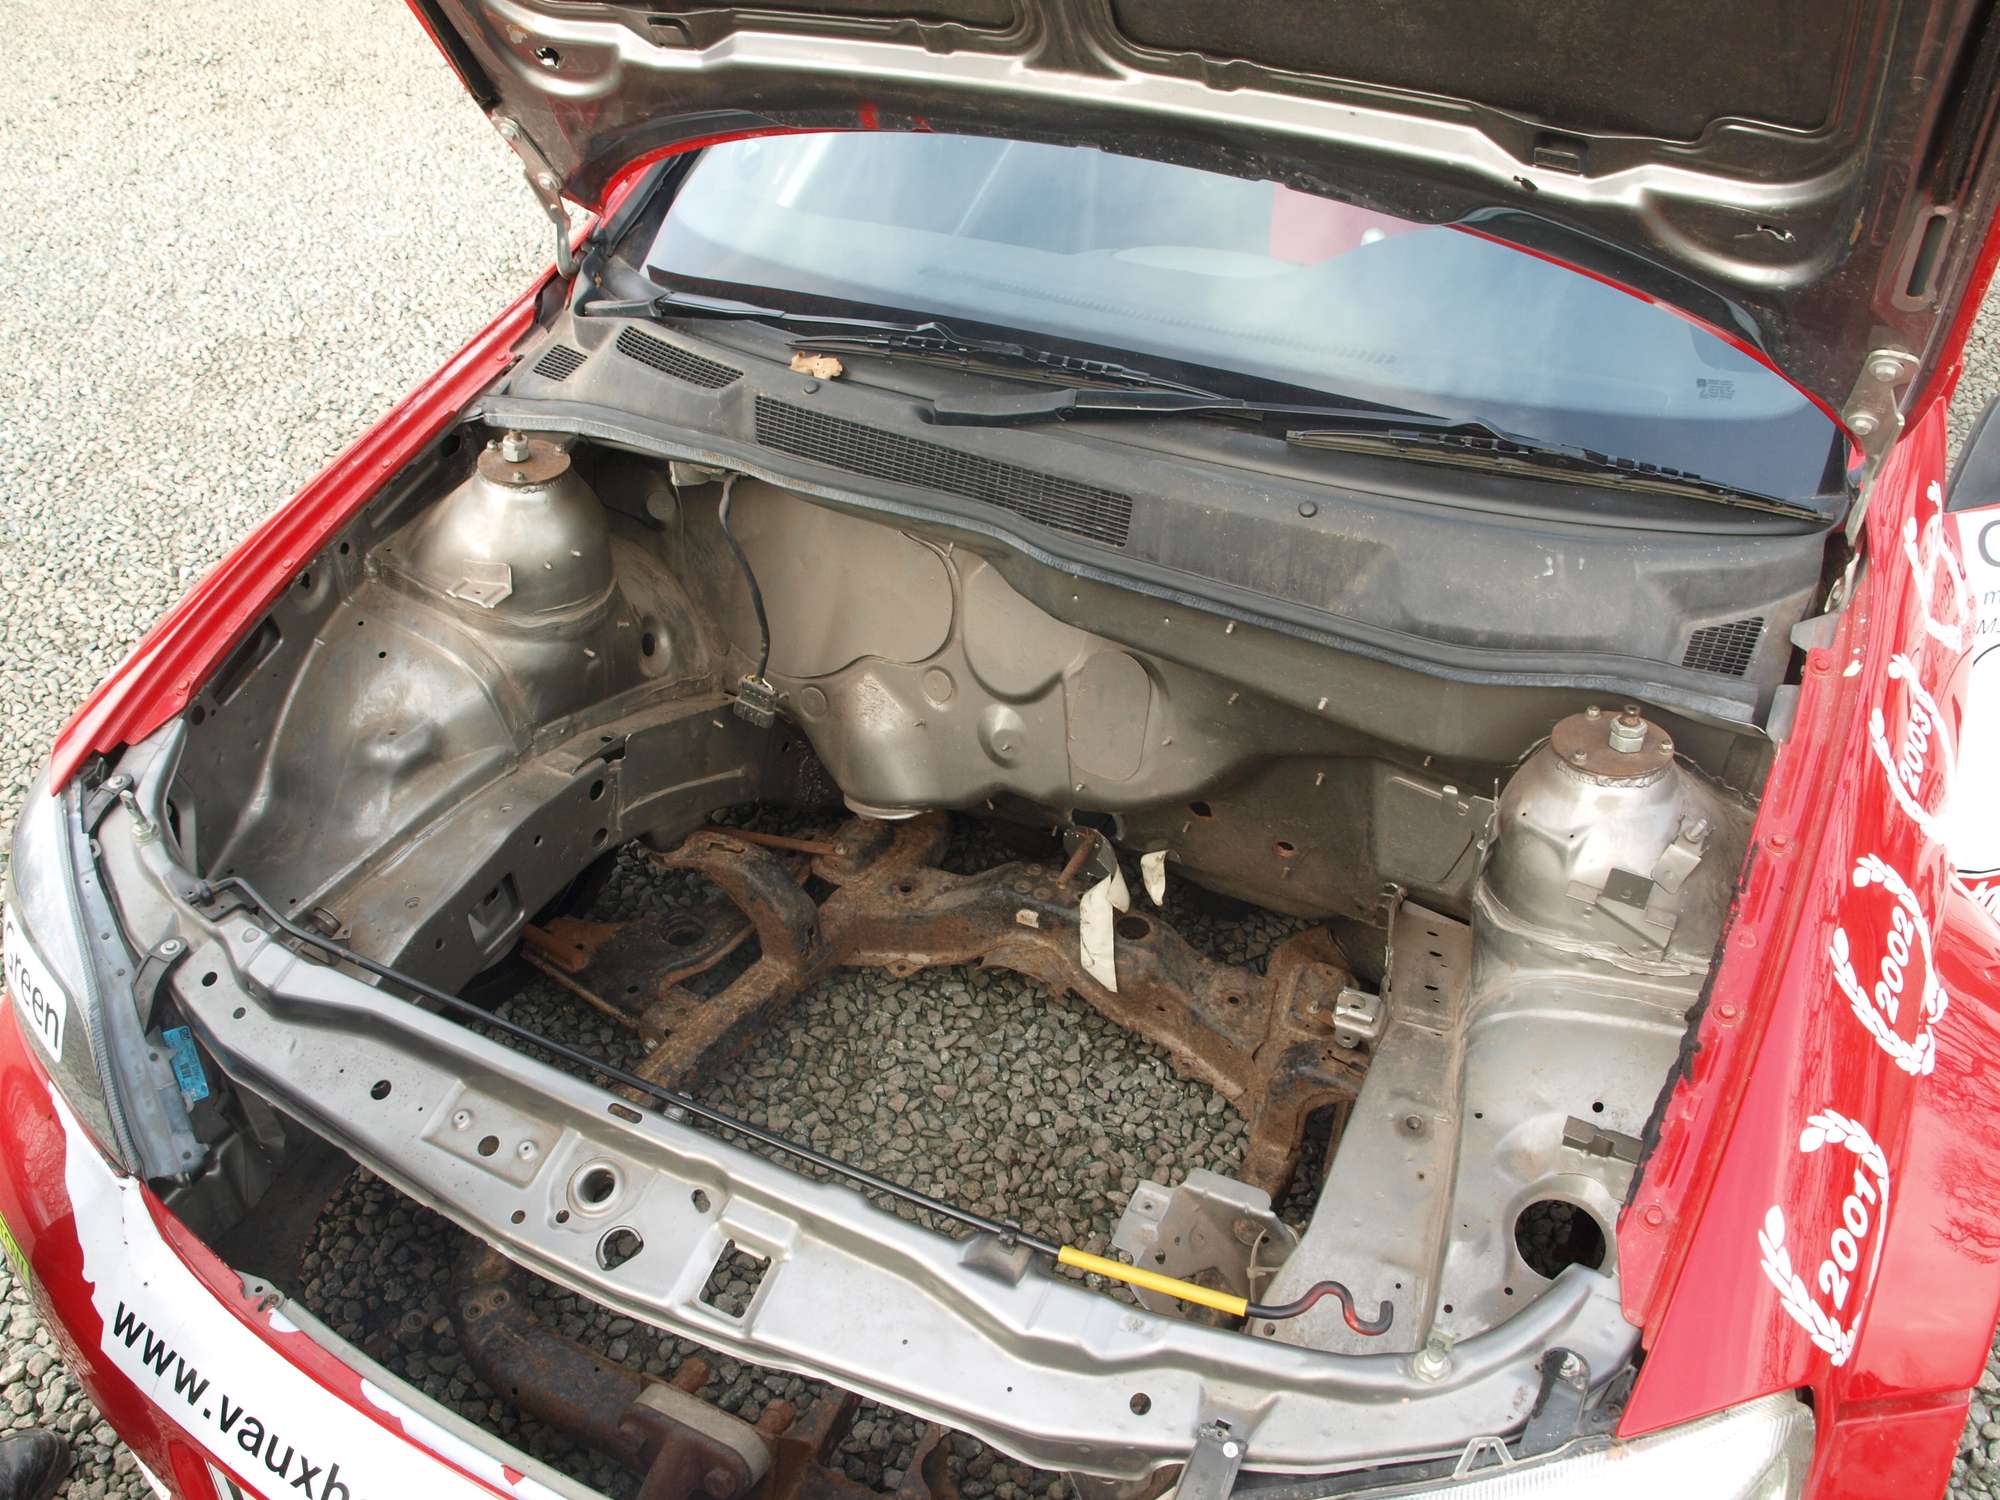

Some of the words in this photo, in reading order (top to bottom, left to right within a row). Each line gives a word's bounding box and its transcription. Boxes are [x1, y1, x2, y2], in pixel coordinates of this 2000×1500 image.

[1900, 703, 1932, 797] 2003
[1875, 906, 1914, 1024] 2002
[1819, 1169, 1876, 1311] 2001
